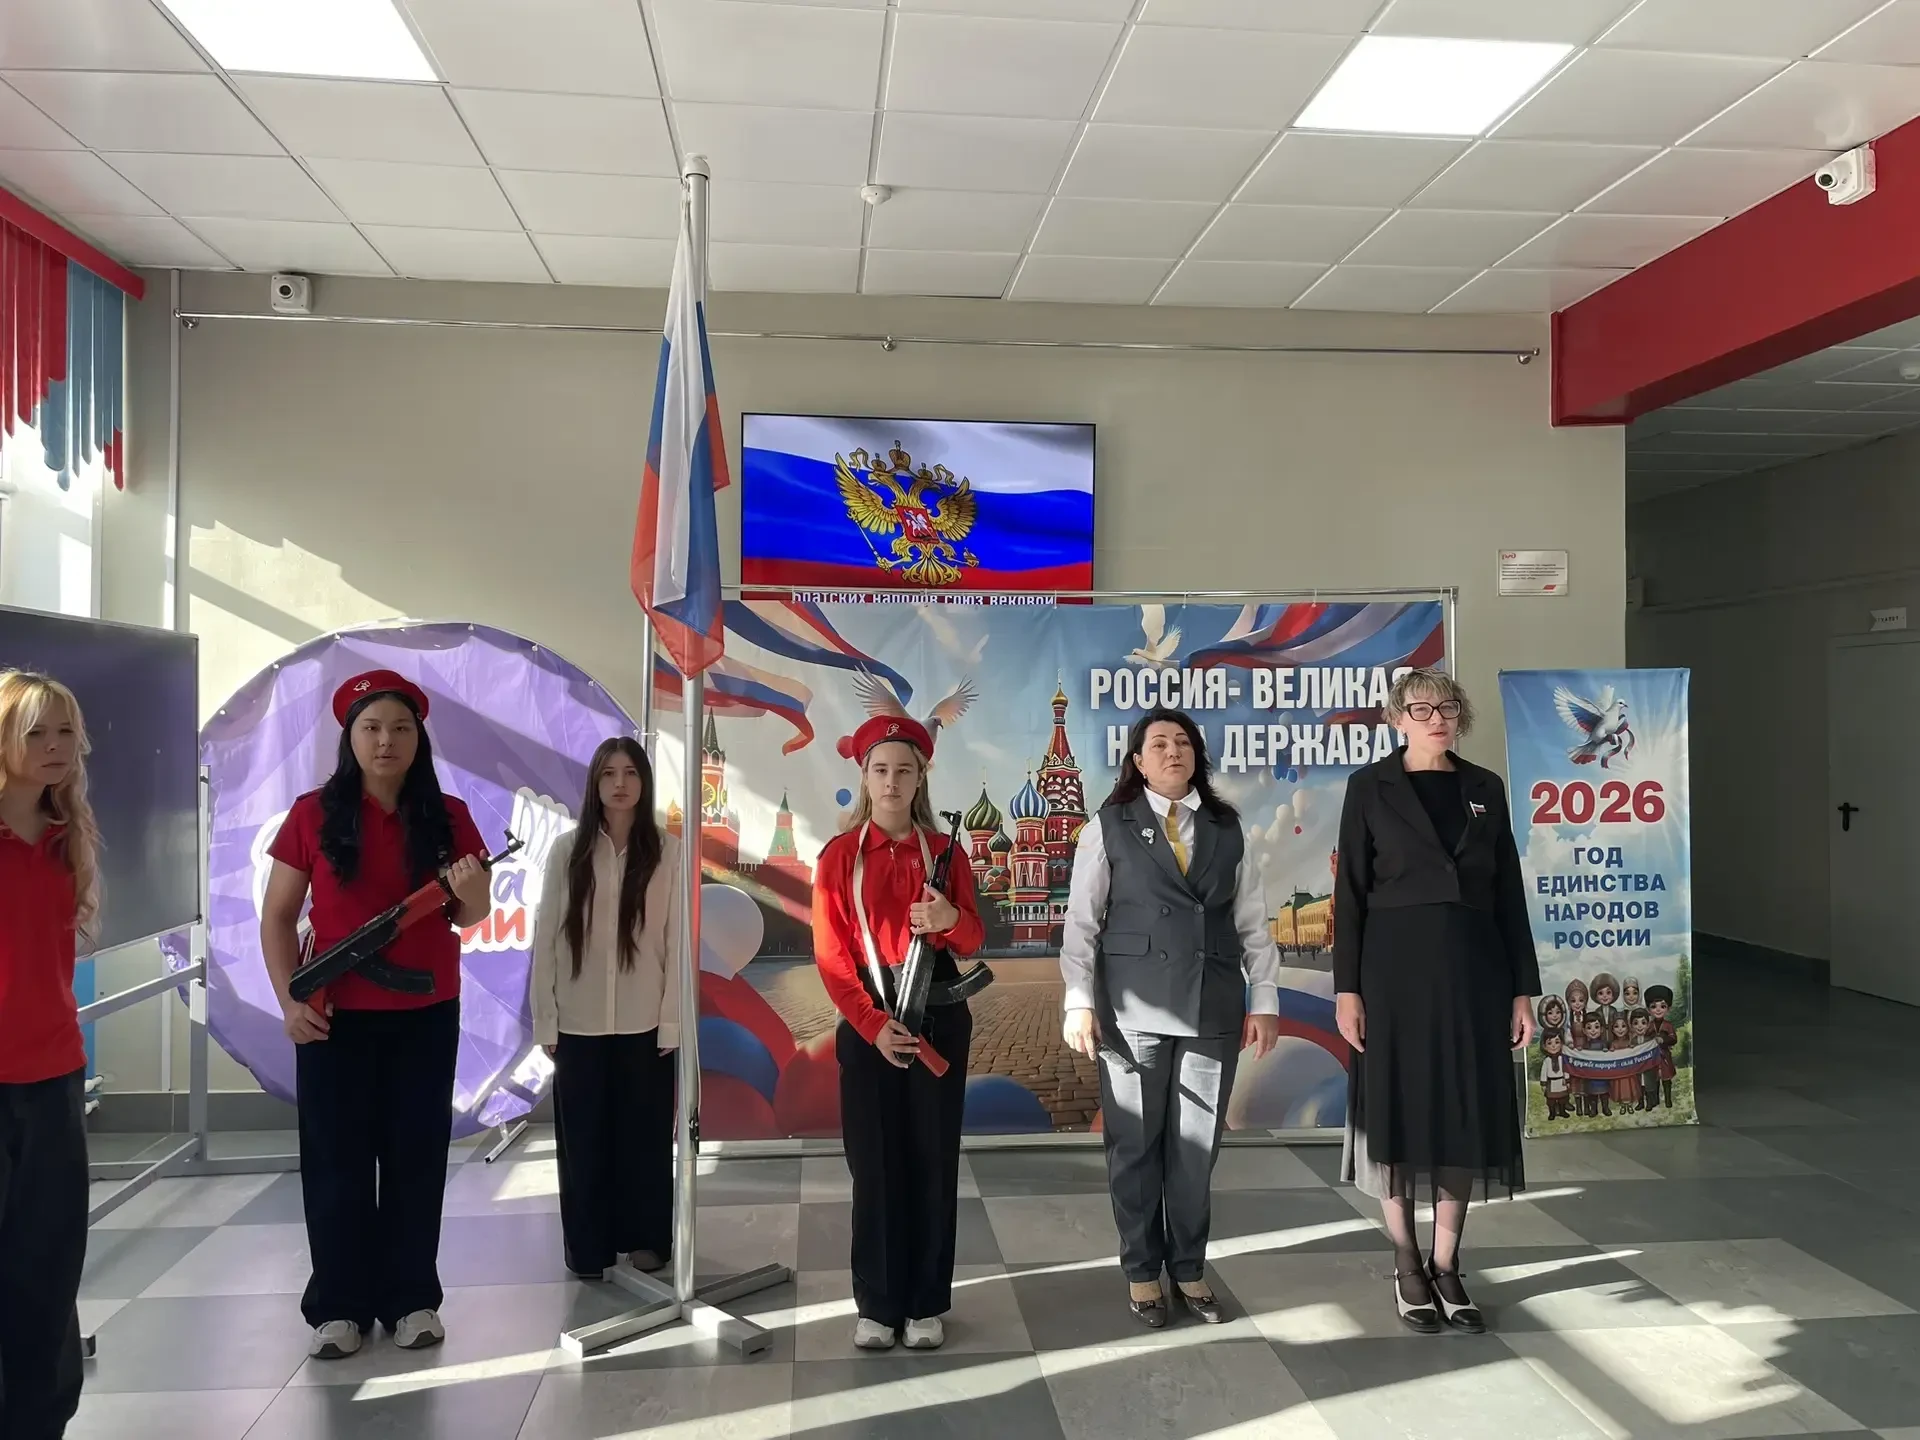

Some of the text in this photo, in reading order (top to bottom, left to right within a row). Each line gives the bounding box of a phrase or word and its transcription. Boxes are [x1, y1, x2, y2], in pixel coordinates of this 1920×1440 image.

[945, 595, 984, 605] союз
[1090, 667, 1241, 710] РОССИЯ-
[1531, 780, 1666, 824] 2026
[1573, 847, 1624, 868] ГОД
[1536, 874, 1666, 897] ЕДИНСТВА
[1544, 901, 1660, 923] НАРОДОВ
[1554, 929, 1651, 949] РОССИИ
